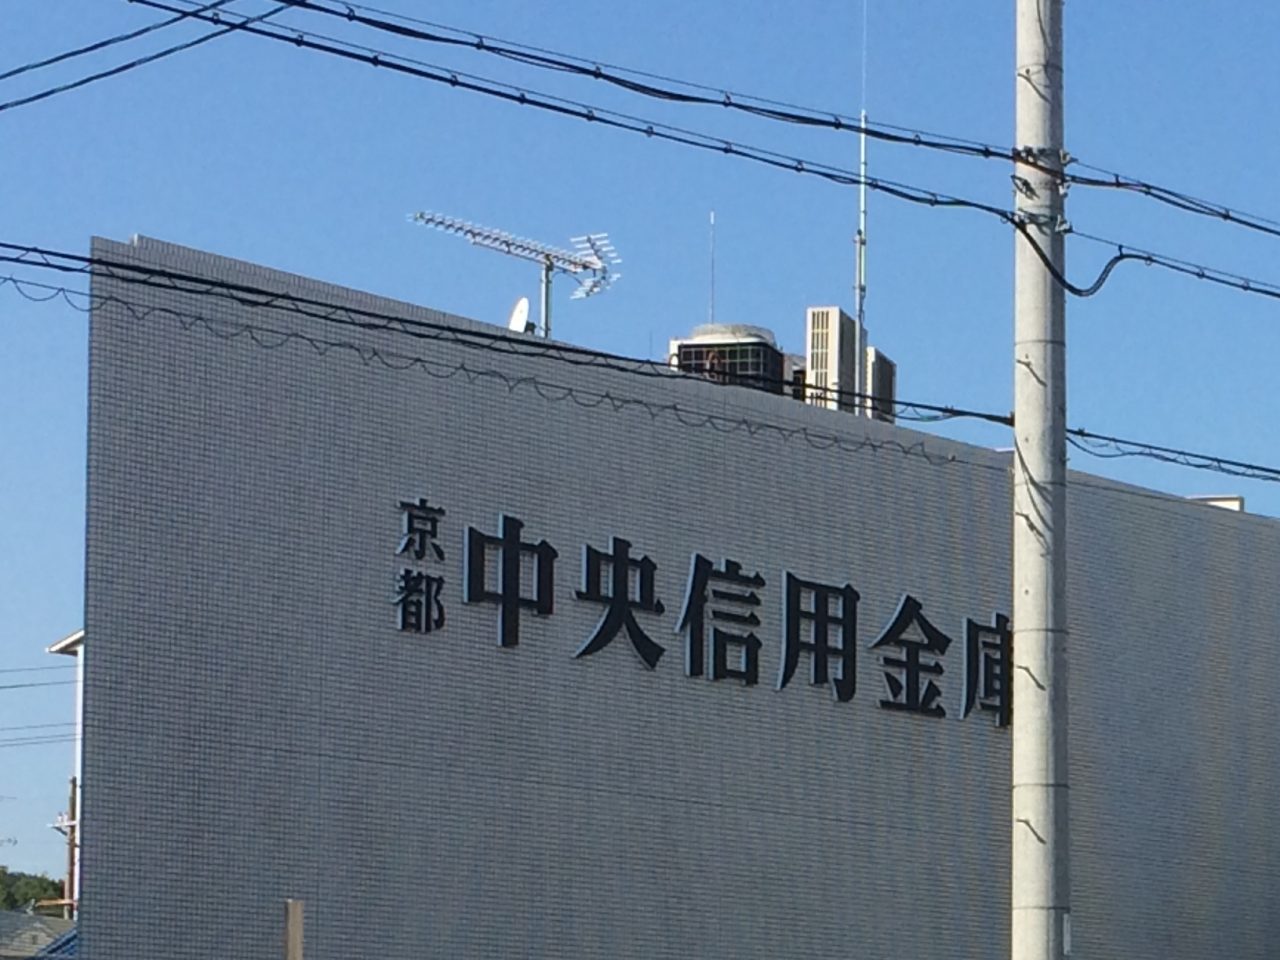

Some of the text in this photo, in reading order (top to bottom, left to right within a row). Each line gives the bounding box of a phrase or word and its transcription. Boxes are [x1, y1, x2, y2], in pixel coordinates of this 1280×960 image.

[394, 498, 446, 635] 京都
[463, 512, 1012, 727] 中央信用金庫
